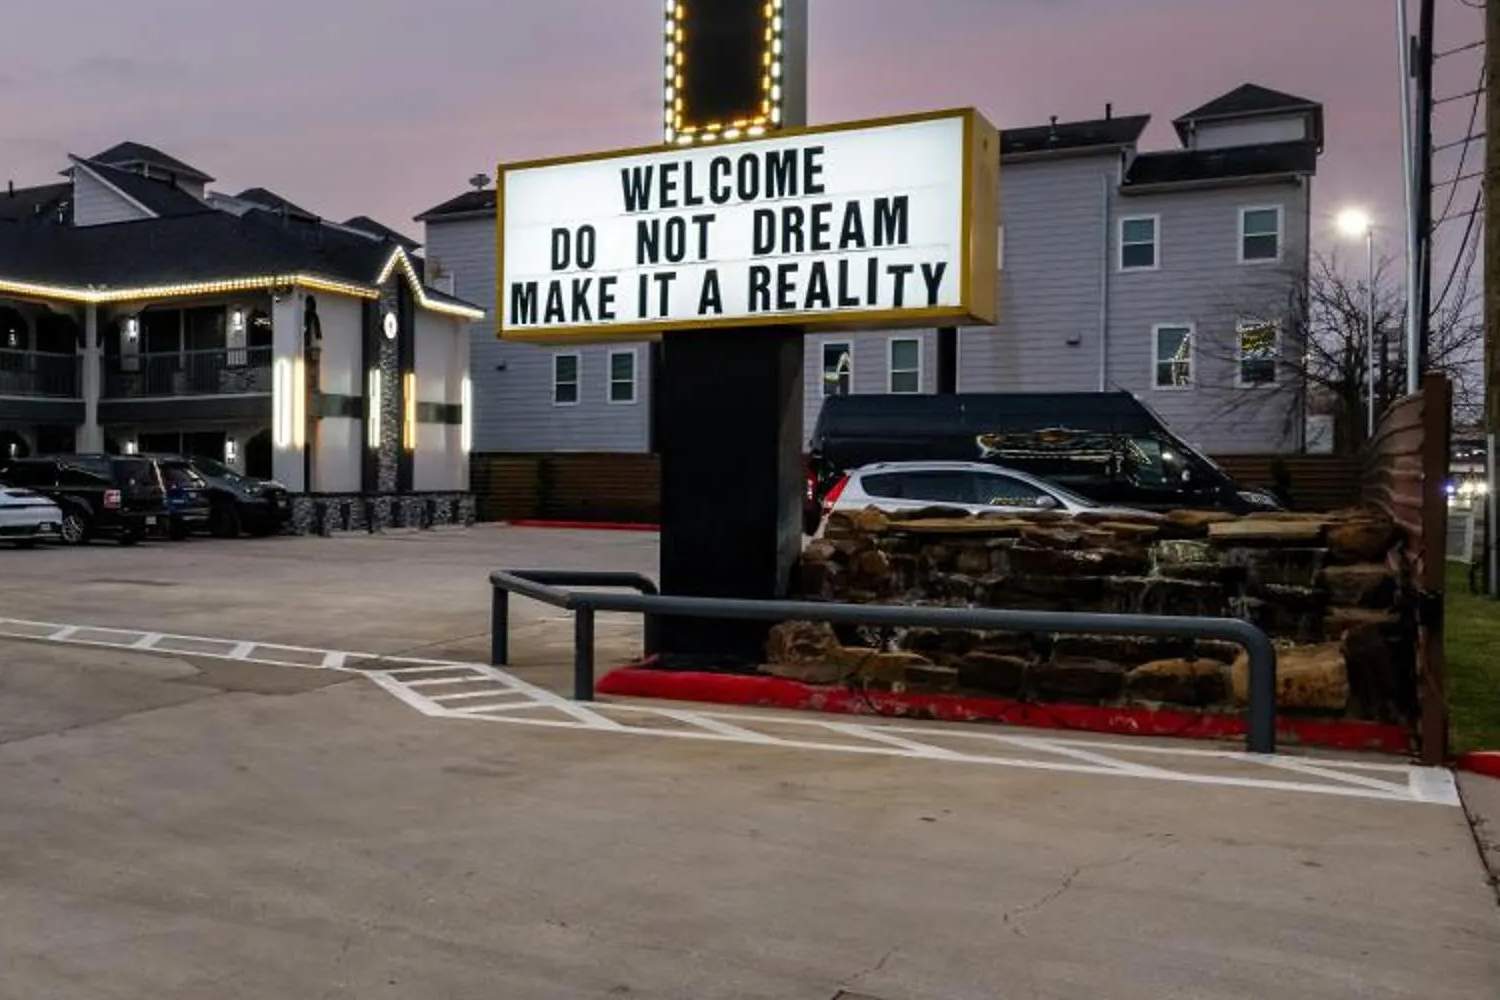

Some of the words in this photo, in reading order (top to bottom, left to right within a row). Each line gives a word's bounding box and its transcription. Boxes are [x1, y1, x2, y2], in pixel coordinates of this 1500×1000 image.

[621, 146, 825, 213] WELCOME
[551, 224, 596, 271] DO
[636, 214, 716, 265] NOT
[752, 196, 909, 256] DREAM
[510, 276, 617, 325] MAKE
[639, 272, 676, 317] IT
[697, 269, 723, 316] A
[747, 257, 948, 313] REALITY
